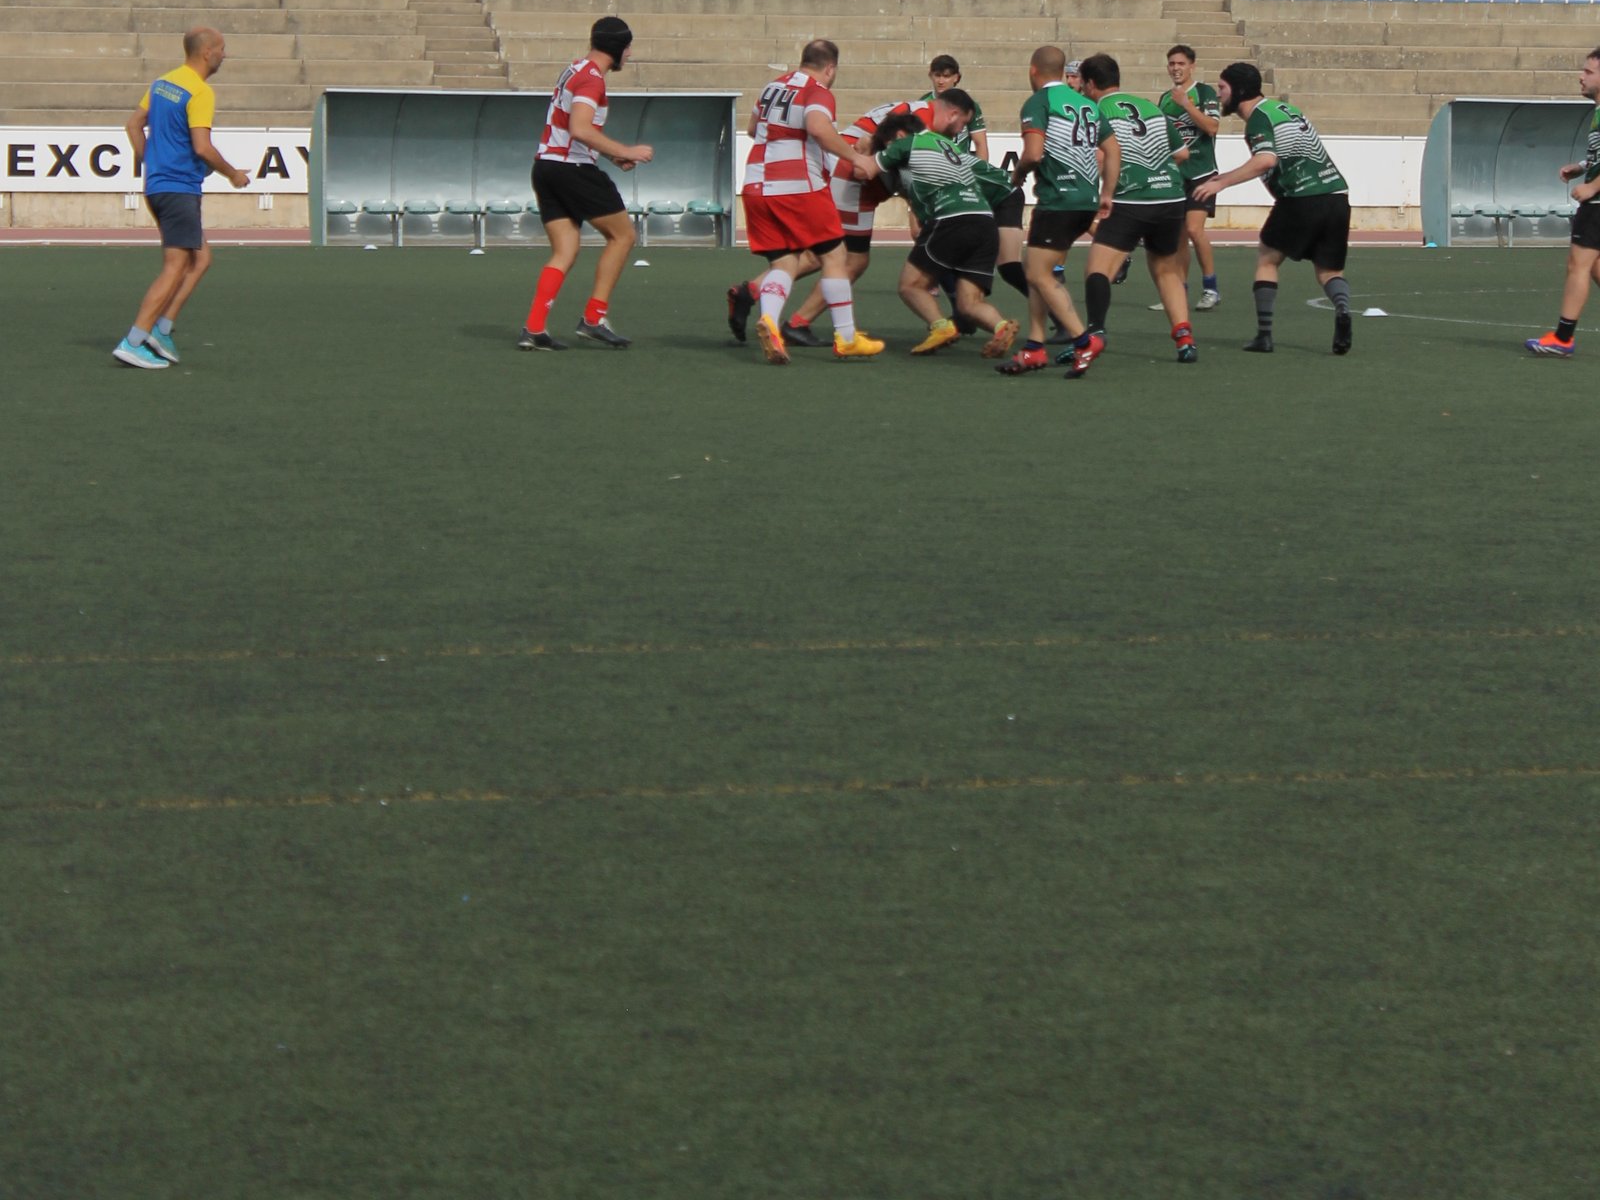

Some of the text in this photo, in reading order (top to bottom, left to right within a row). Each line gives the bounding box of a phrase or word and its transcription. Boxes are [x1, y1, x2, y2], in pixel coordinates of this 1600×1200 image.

[760, 86, 799, 124] 44
[1115, 102, 1147, 137] 3
[1063, 104, 1097, 148] 26
[7, 143, 142, 178] EXC
[935, 138, 962, 166] 8
